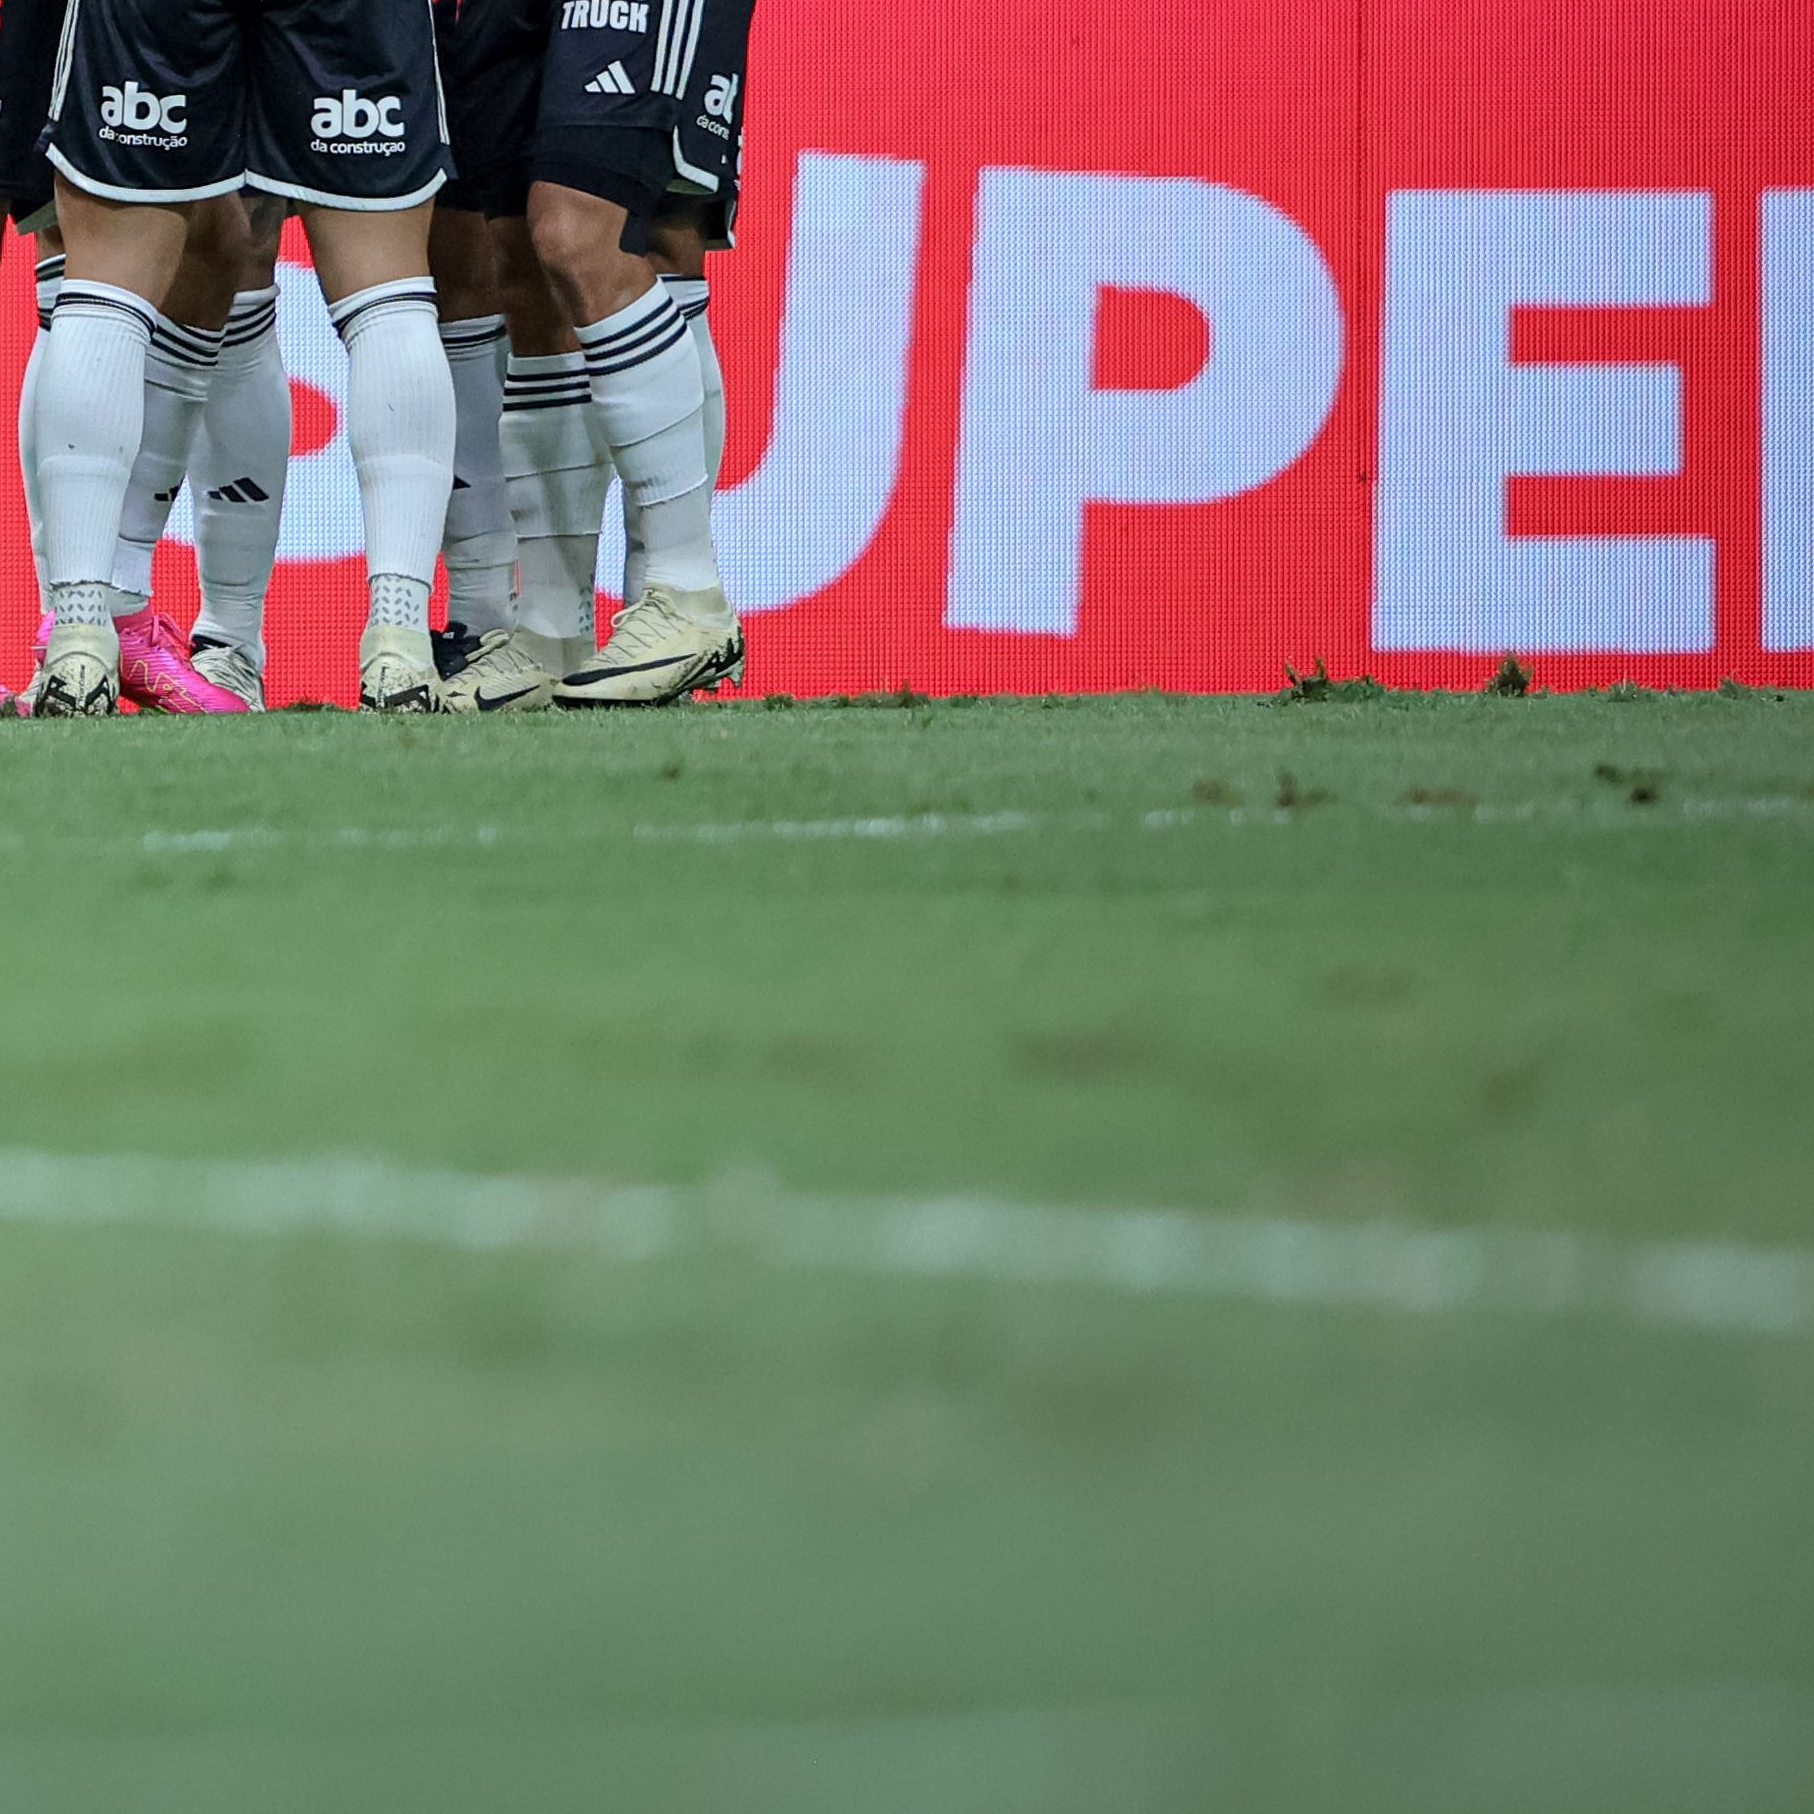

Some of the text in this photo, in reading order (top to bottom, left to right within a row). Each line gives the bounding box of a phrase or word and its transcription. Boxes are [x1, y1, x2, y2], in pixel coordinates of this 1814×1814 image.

[100, 81, 188, 134] abc
[310, 89, 405, 138] abc
[98, 125, 115, 141] da
[310, 139, 328, 153] da
